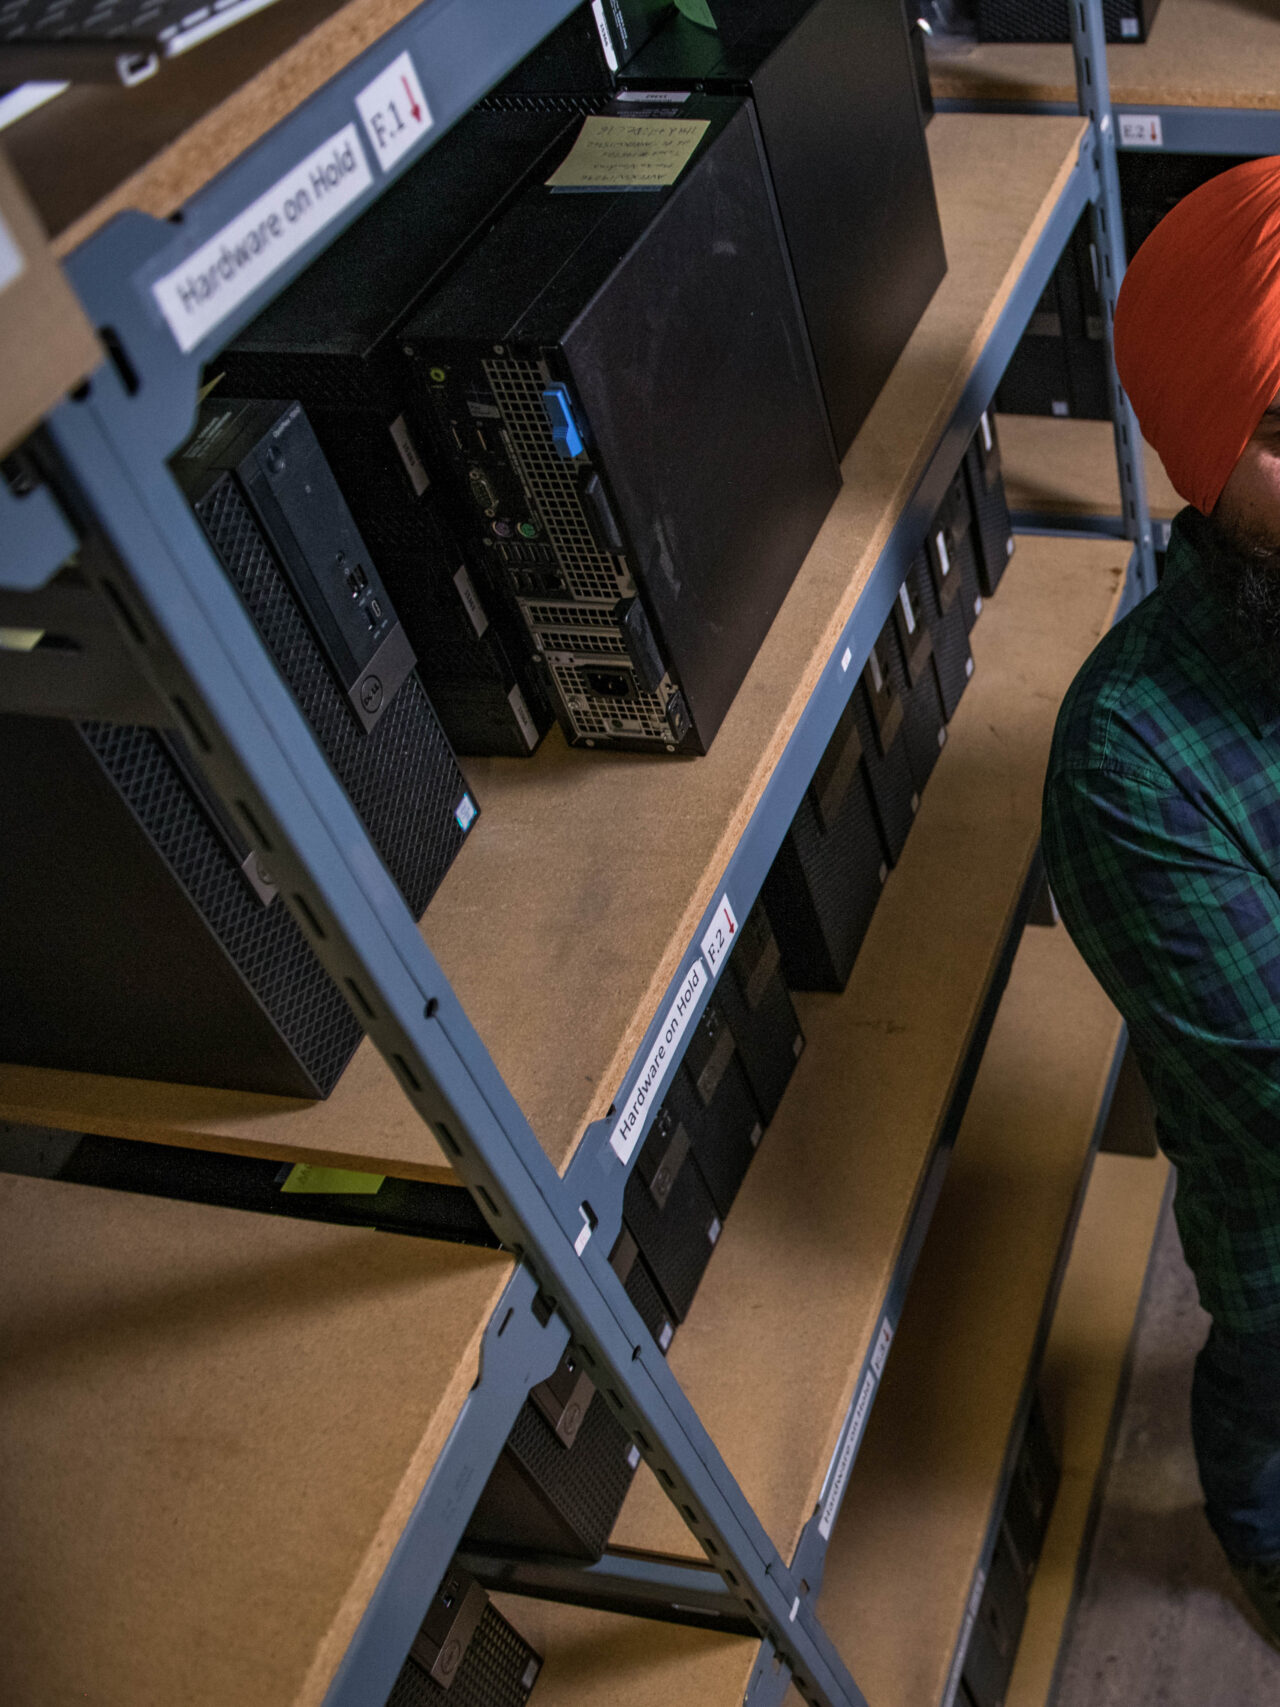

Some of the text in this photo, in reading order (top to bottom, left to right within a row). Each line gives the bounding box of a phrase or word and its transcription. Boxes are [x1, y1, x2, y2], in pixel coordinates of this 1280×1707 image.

[370, 101, 405, 149] F.1
[177, 141, 356, 313] Hardware on Hold
[708, 928, 725, 964] F.2
[619, 968, 700, 1141] Hardware on Hold
[824, 1381, 872, 1524] Hardware on Hold
